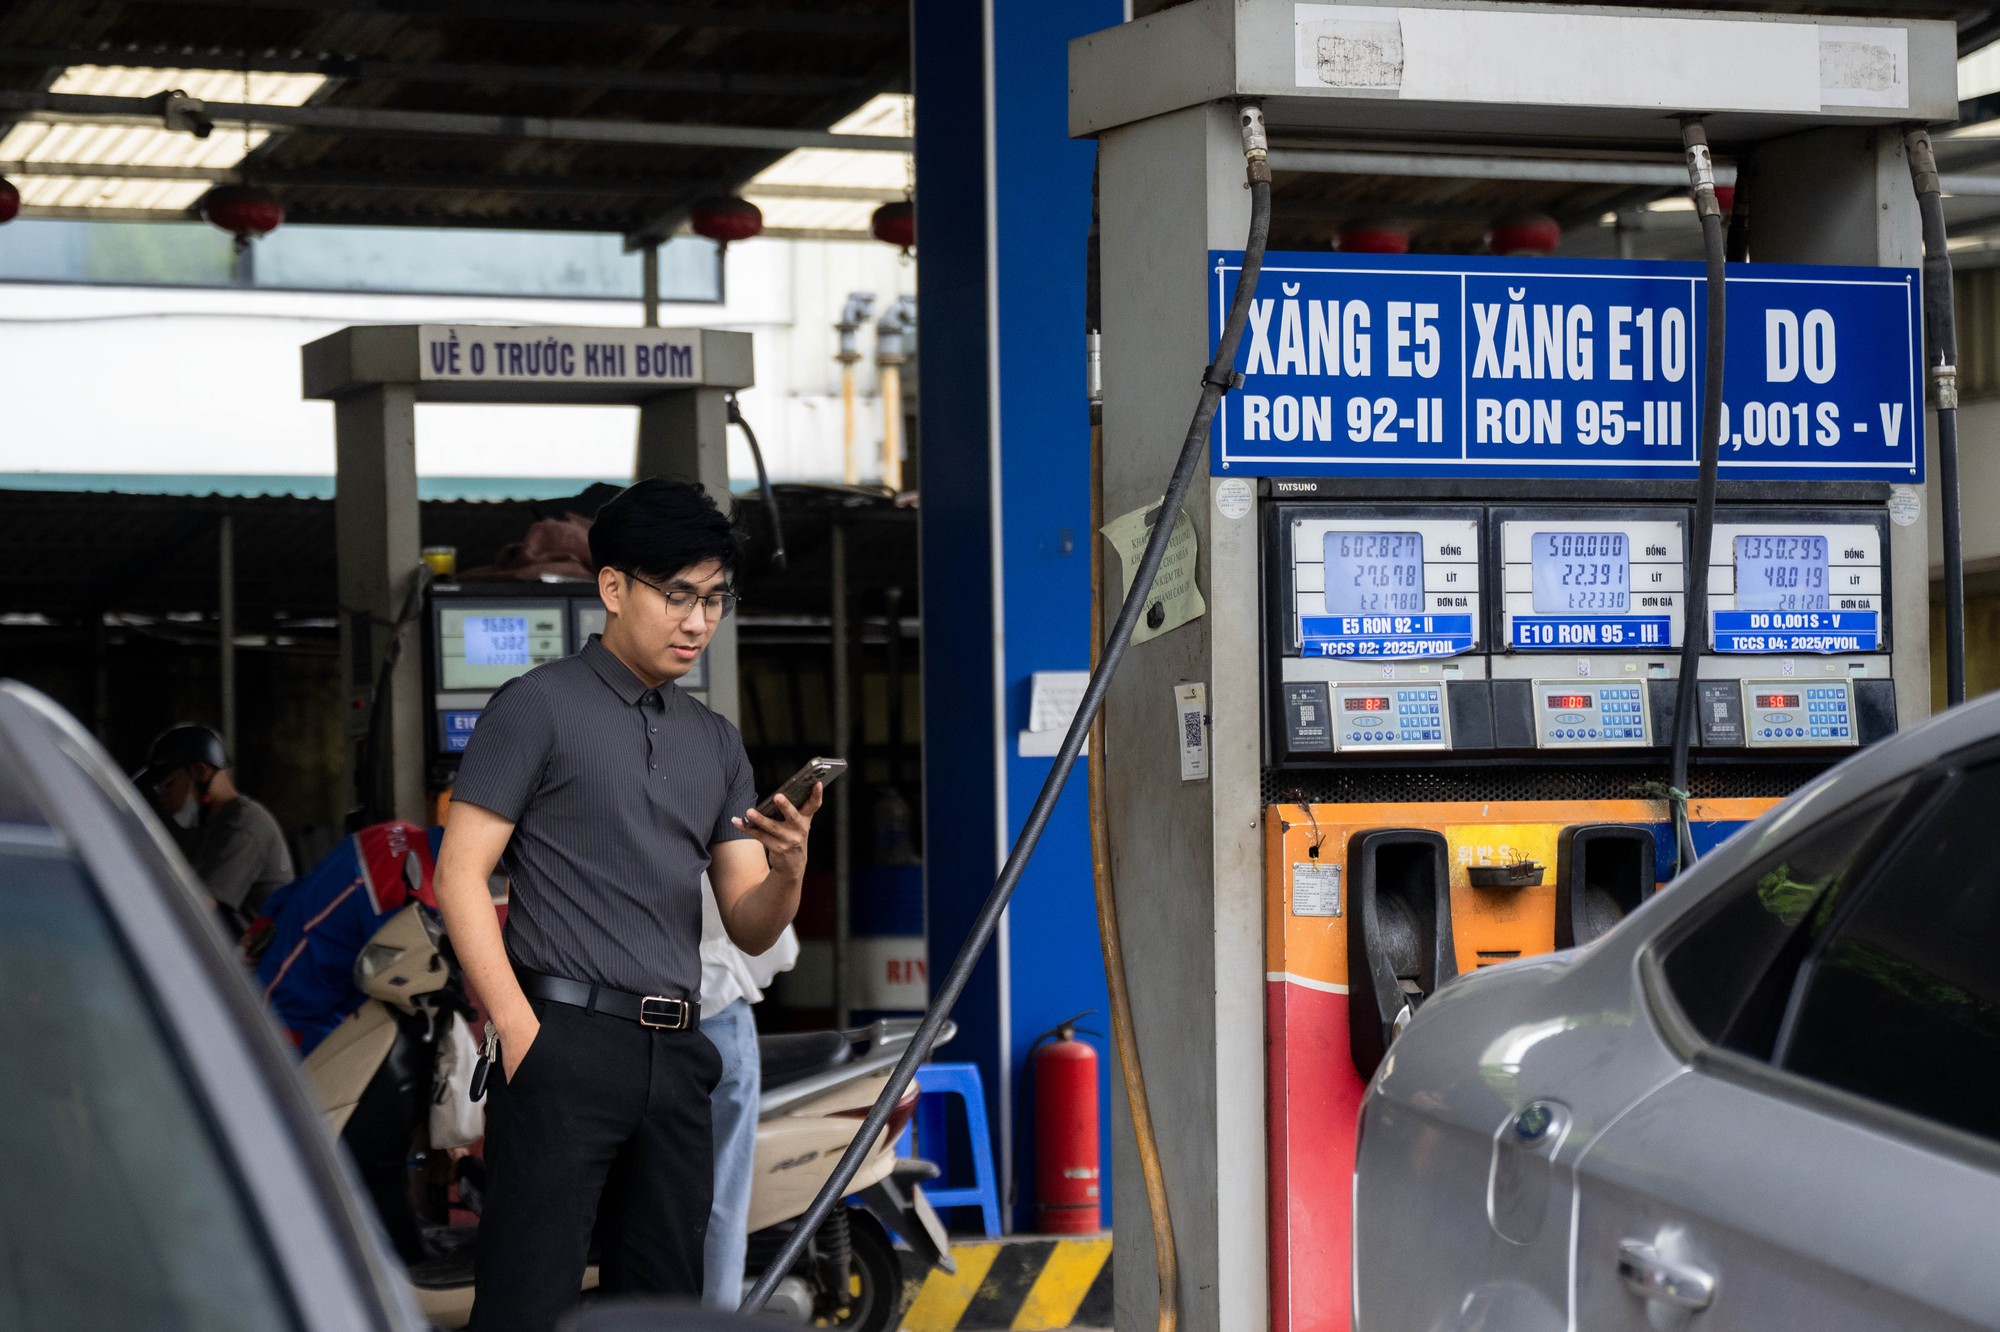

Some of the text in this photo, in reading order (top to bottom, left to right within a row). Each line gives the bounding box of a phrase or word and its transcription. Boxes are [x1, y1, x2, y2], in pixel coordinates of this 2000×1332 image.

[1245, 282, 1440, 379] XĂNG E5
[1471, 287, 1686, 383] XĂNG E10
[430, 329, 461, 375] VỀ
[494, 337, 574, 376] TRƯỚC
[584, 344, 625, 377] KHI
[635, 341, 692, 378] BƠM
[1766, 309, 1836, 384] DO
[1244, 395, 1443, 443] RON 92-II
[1476, 398, 1682, 446] RON 95-III
[1853, 423, 1867, 432] -
[1879, 403, 1903, 446] V
[1278, 483, 1317, 491] TATSUNO
[1446, 571, 1457, 582] LÍT
[1651, 571, 1662, 582] LÍT
[1850, 574, 1860, 585] LÍT
[1437, 595, 1467, 607] ĐƠN GIÁ
[1642, 595, 1673, 607] ĐƠN GIÁ
[1841, 598, 1870, 609] ĐƠN GIÁ
[1342, 617, 1359, 634] E5
[1363, 617, 1391, 634] RON
[1395, 617, 1412, 633] 92
[1424, 617, 1433, 632] II
[1751, 614, 1769, 628] DO
[1773, 614, 1819, 629] 0,001S
[1832, 615, 1840, 628] V
[1520, 625, 1553, 643] E10
[1559, 624, 1596, 643] RON
[1601, 624, 1623, 643] 95
[1641, 624, 1658, 642] III
[1321, 641, 1455, 656] TCCS 02: 2025/PVOIL
[1732, 637, 1860, 650] TCCS 04: 2025/PVOIL
